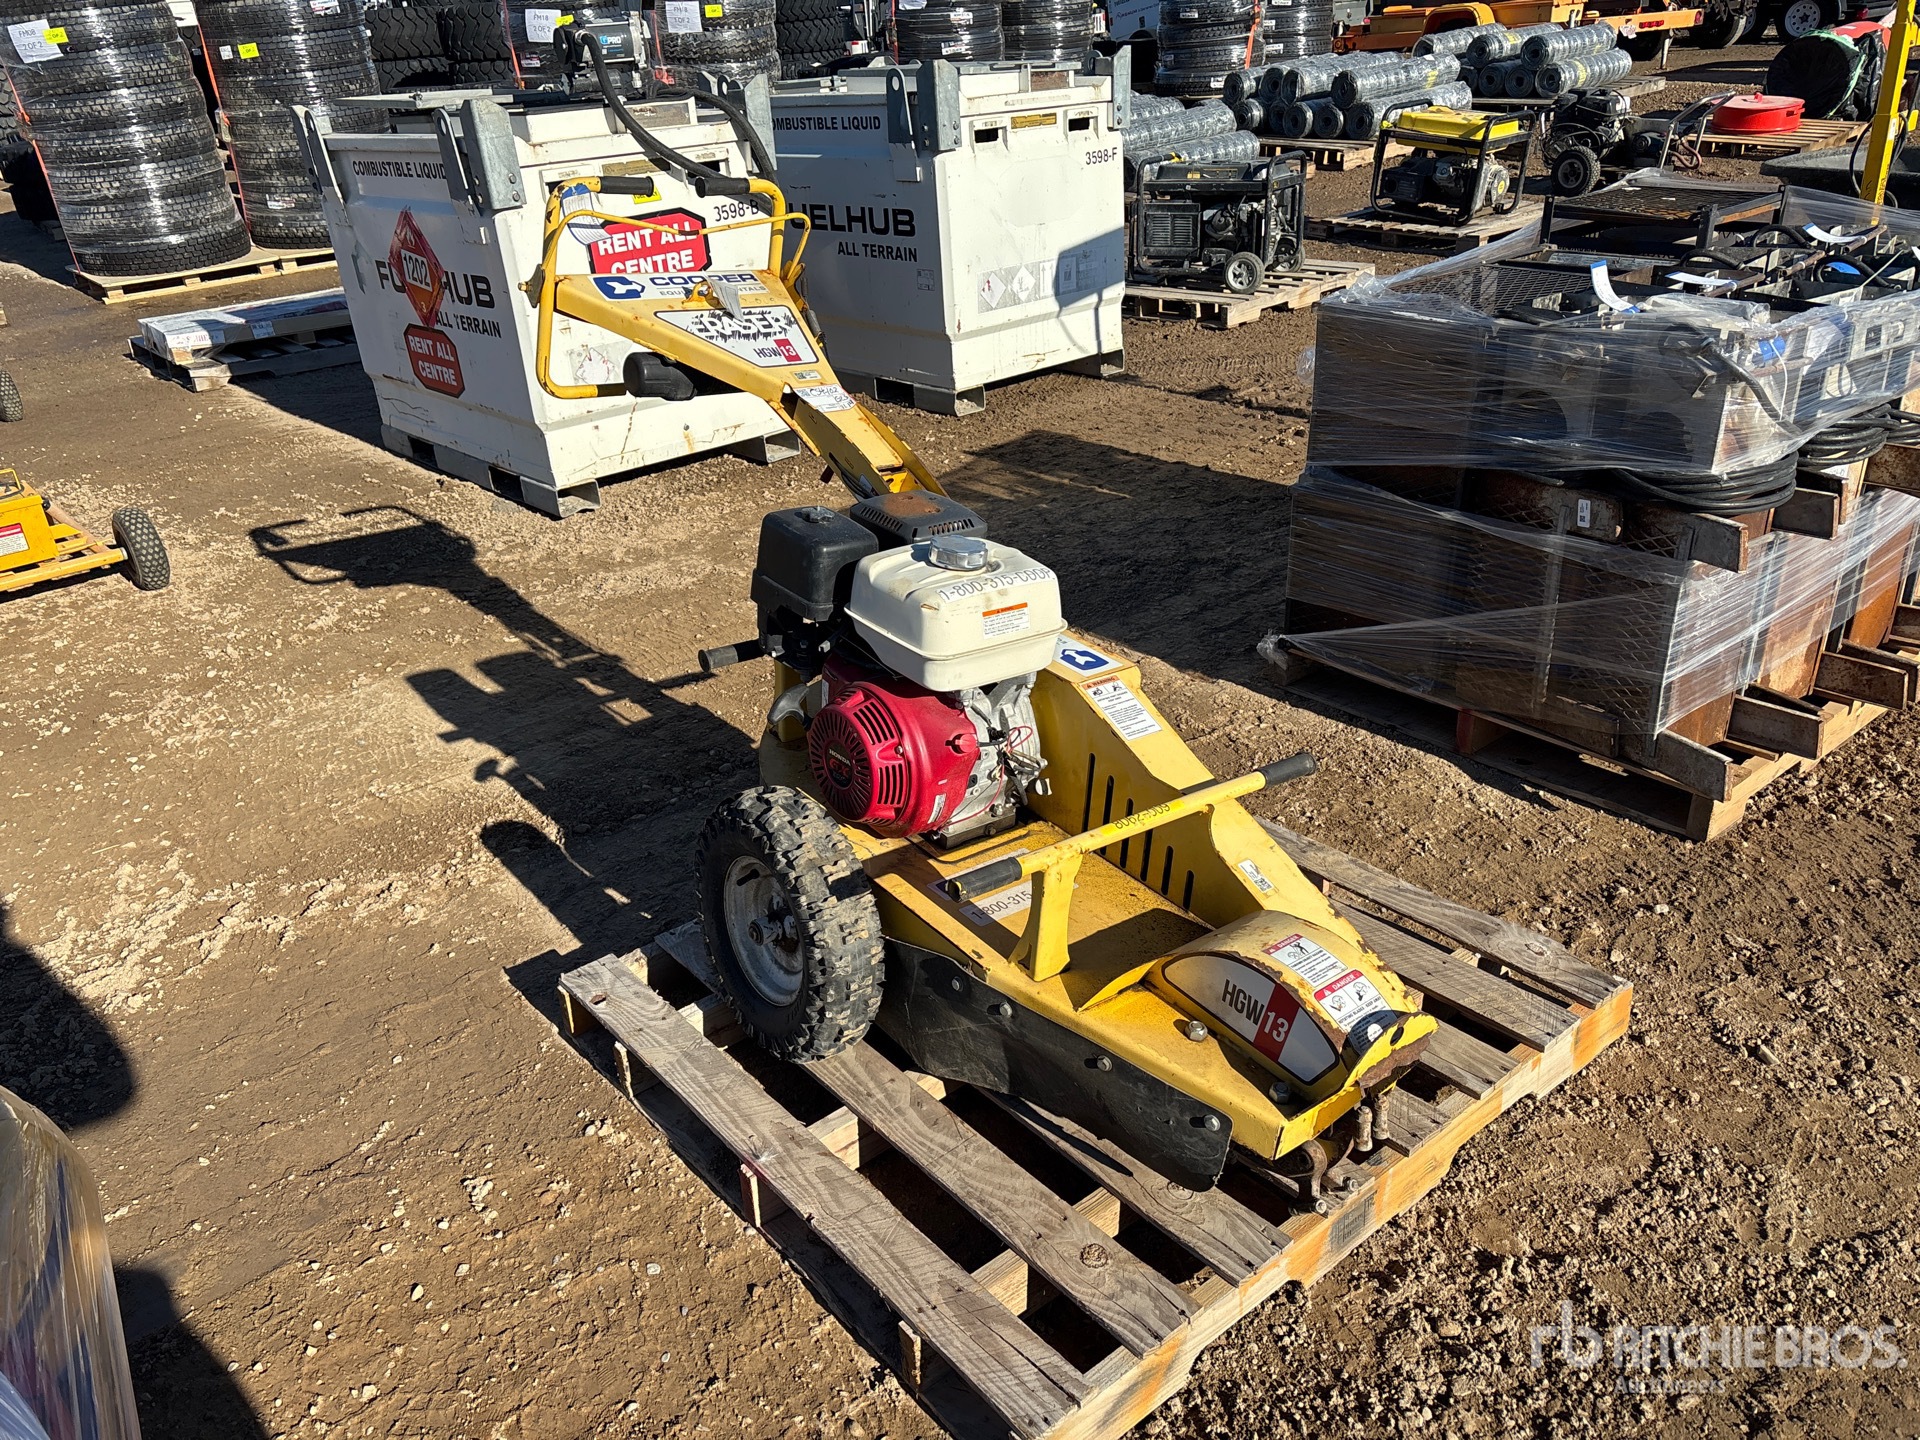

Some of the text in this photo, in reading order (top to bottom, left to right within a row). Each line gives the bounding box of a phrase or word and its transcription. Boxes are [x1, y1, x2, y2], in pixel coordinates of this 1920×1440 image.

[28, 41, 37, 50] OF
[771, 115, 881, 131] OMBUSTIBLE LIQUID
[1085, 146, 1118, 166] 3598-F
[352, 160, 447, 180] COMBUSTIBLE LIQUID
[714, 200, 759, 222] 3598-B
[788, 202, 916, 238] UELHUB
[598, 220, 698, 256] RENT ALL
[610, 249, 695, 274] CENTRE
[838, 241, 918, 263] ALL TERRAIN
[402, 252, 431, 288] 1202
[420, 301, 427, 313] 3
[436, 310, 502, 339] ALL TERRAIN
[690, 312, 789, 338] ERASER
[408, 334, 456, 362] RENT ALL
[753, 345, 797, 360] HGW 13
[418, 360, 458, 386] CENTRE
[828, 748, 851, 767] HONDA
[829, 758, 850, 776] GX
[1278, 935, 1299, 948] DANGER
[1332, 972, 1356, 990] DANGER
[1222, 978, 1289, 1042] HGW 13
